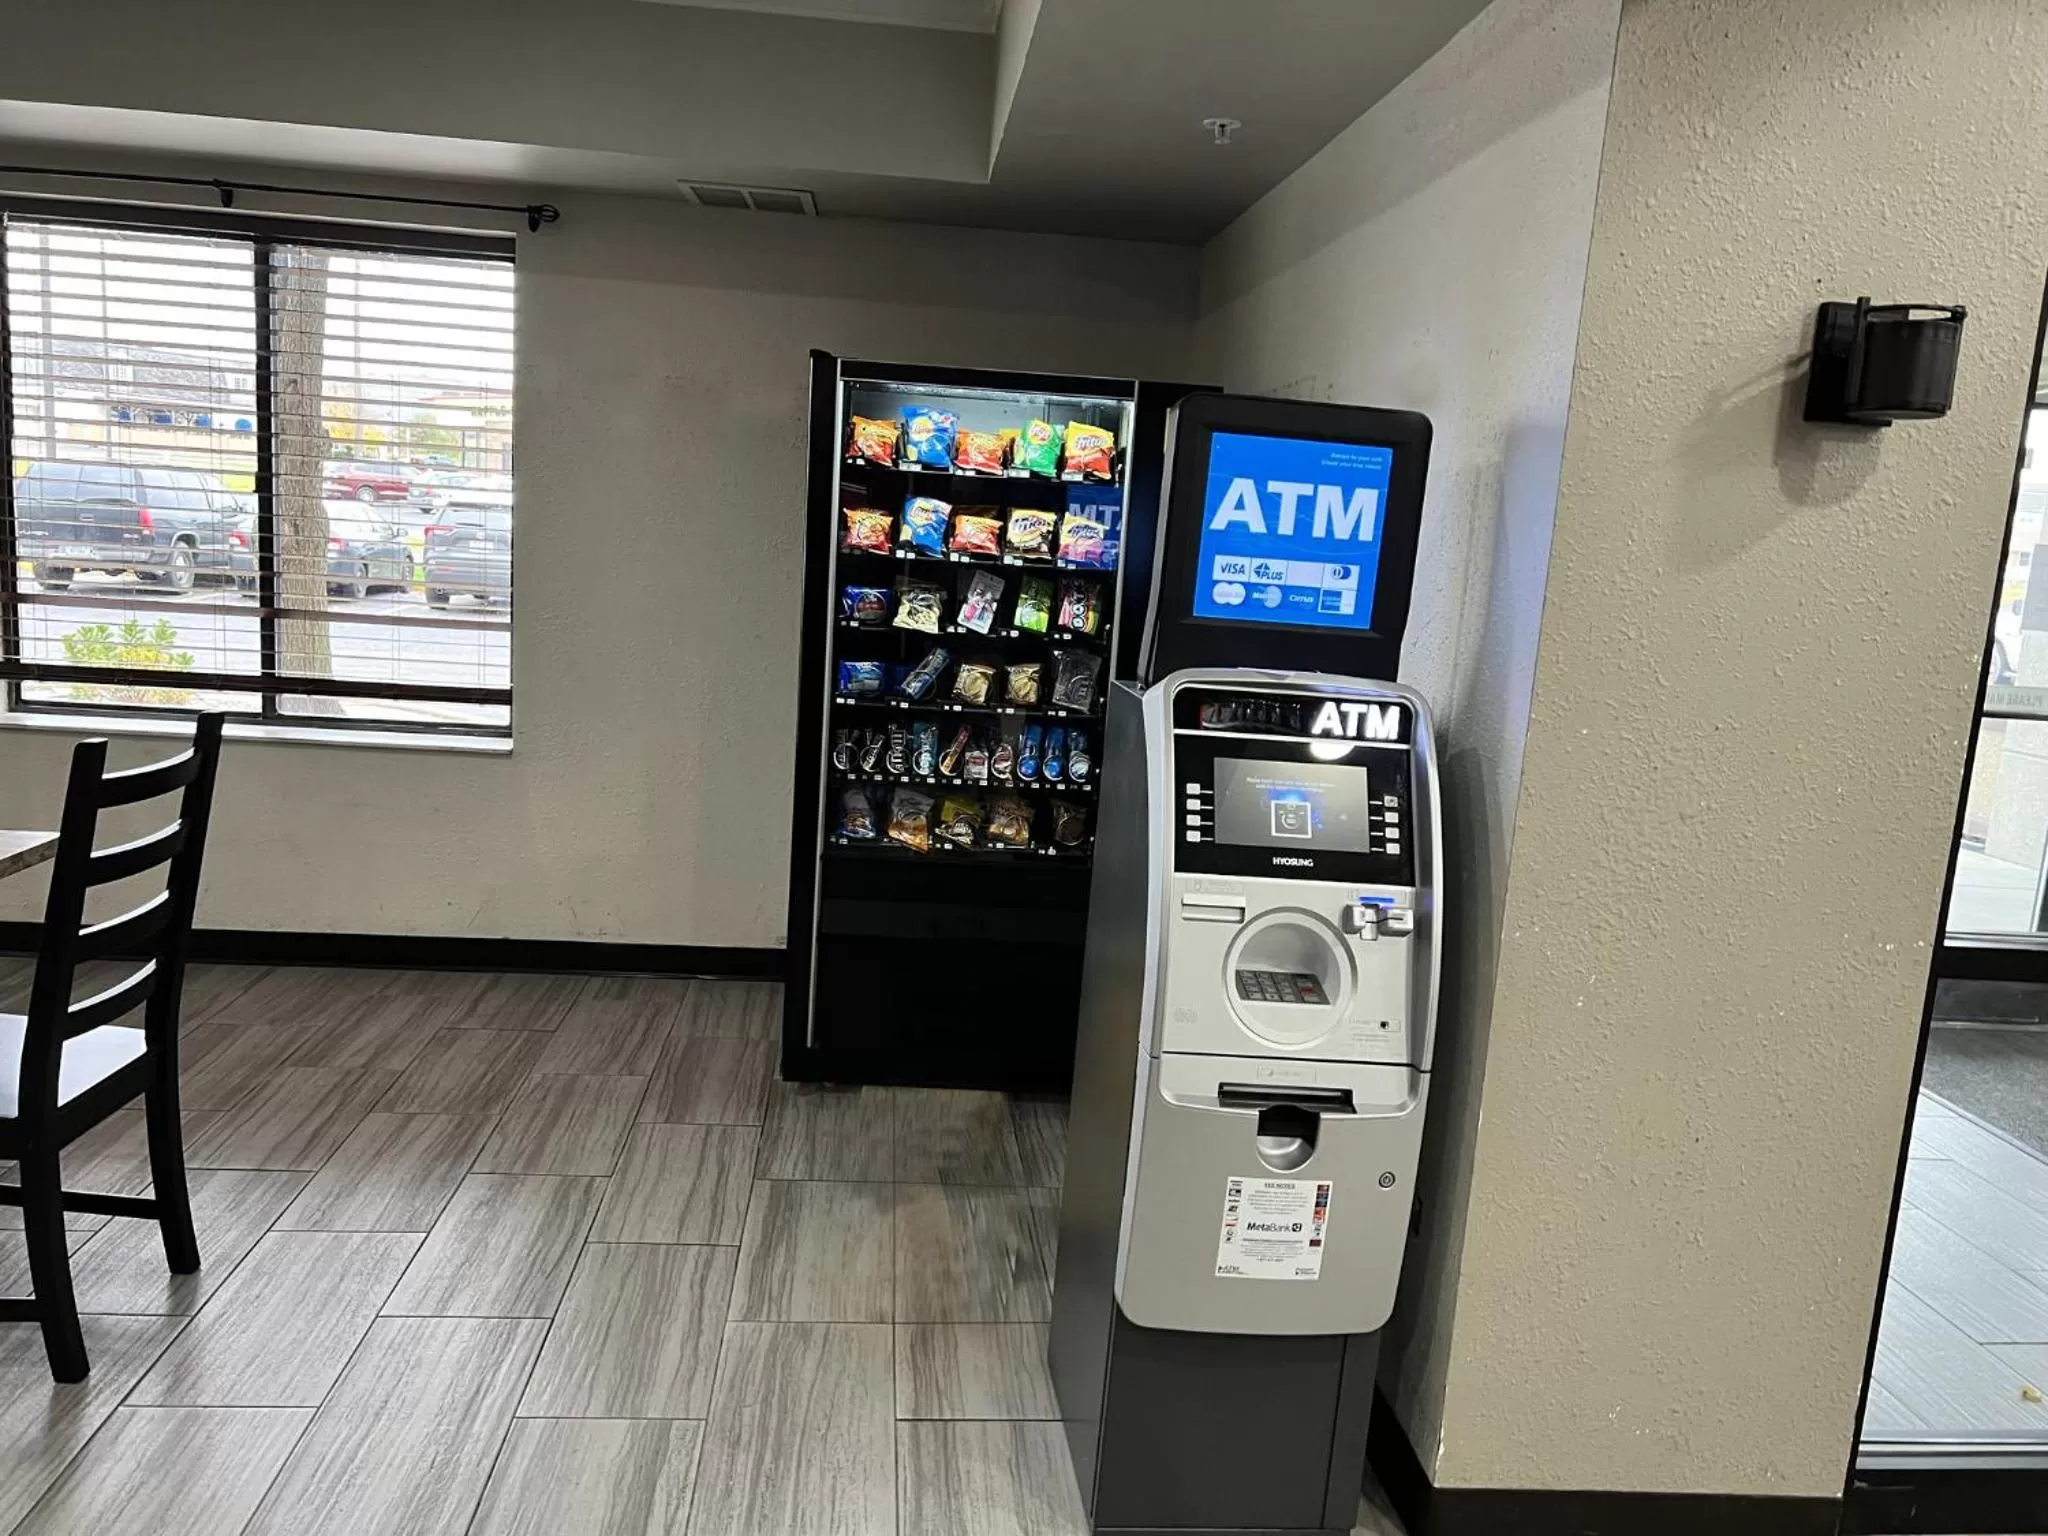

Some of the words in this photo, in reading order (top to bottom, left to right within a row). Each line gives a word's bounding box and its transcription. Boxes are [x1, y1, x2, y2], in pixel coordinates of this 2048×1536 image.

[1210, 477, 1379, 542] ATM
[1220, 562, 1246, 575] VISA
[1261, 570, 1284, 581] PLUS
[1312, 702, 1400, 739] ATM
[1272, 856, 1314, 867] HYOSUNG
[1246, 1222, 1291, 1233] MetaBank
